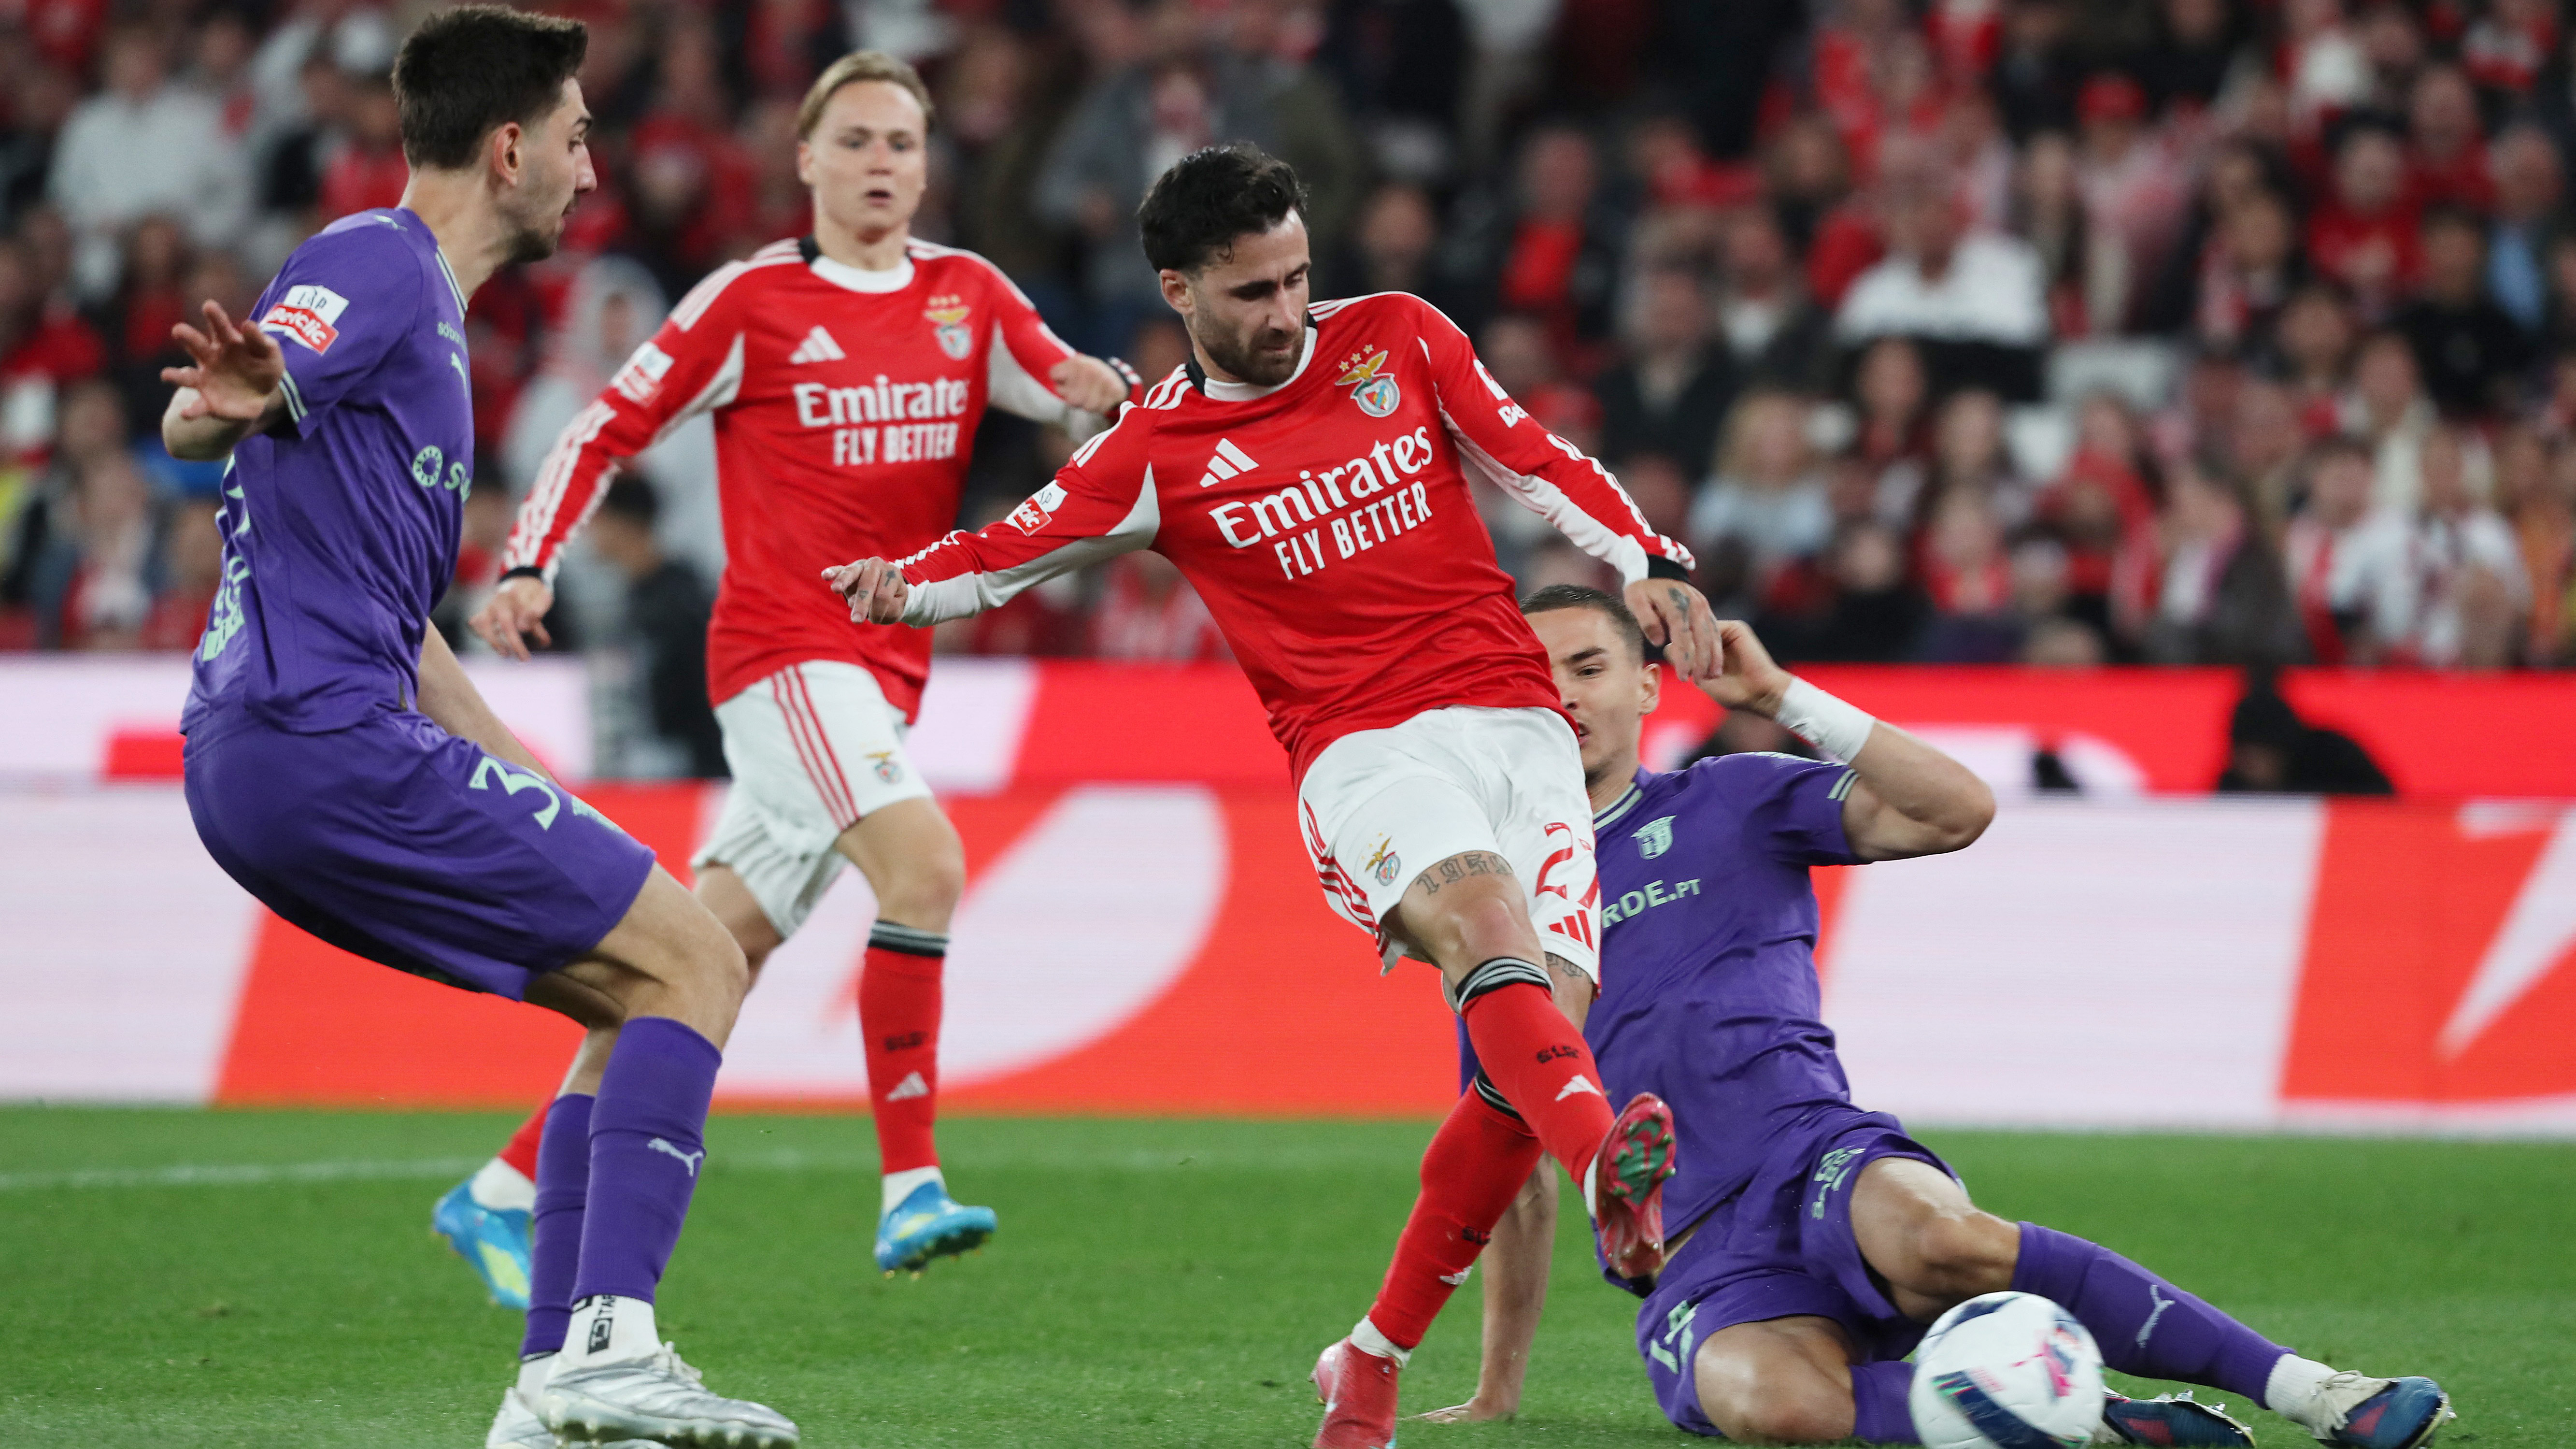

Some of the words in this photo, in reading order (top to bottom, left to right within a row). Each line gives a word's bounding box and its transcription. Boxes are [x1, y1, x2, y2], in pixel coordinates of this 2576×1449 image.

[793, 373, 970, 428] Emirate
[832, 427, 878, 467] FLY
[882, 421, 959, 464] BETTER
[1209, 426, 1433, 549] Emirates
[1274, 528, 1326, 580] FLY
[1331, 480, 1433, 560] BETTER
